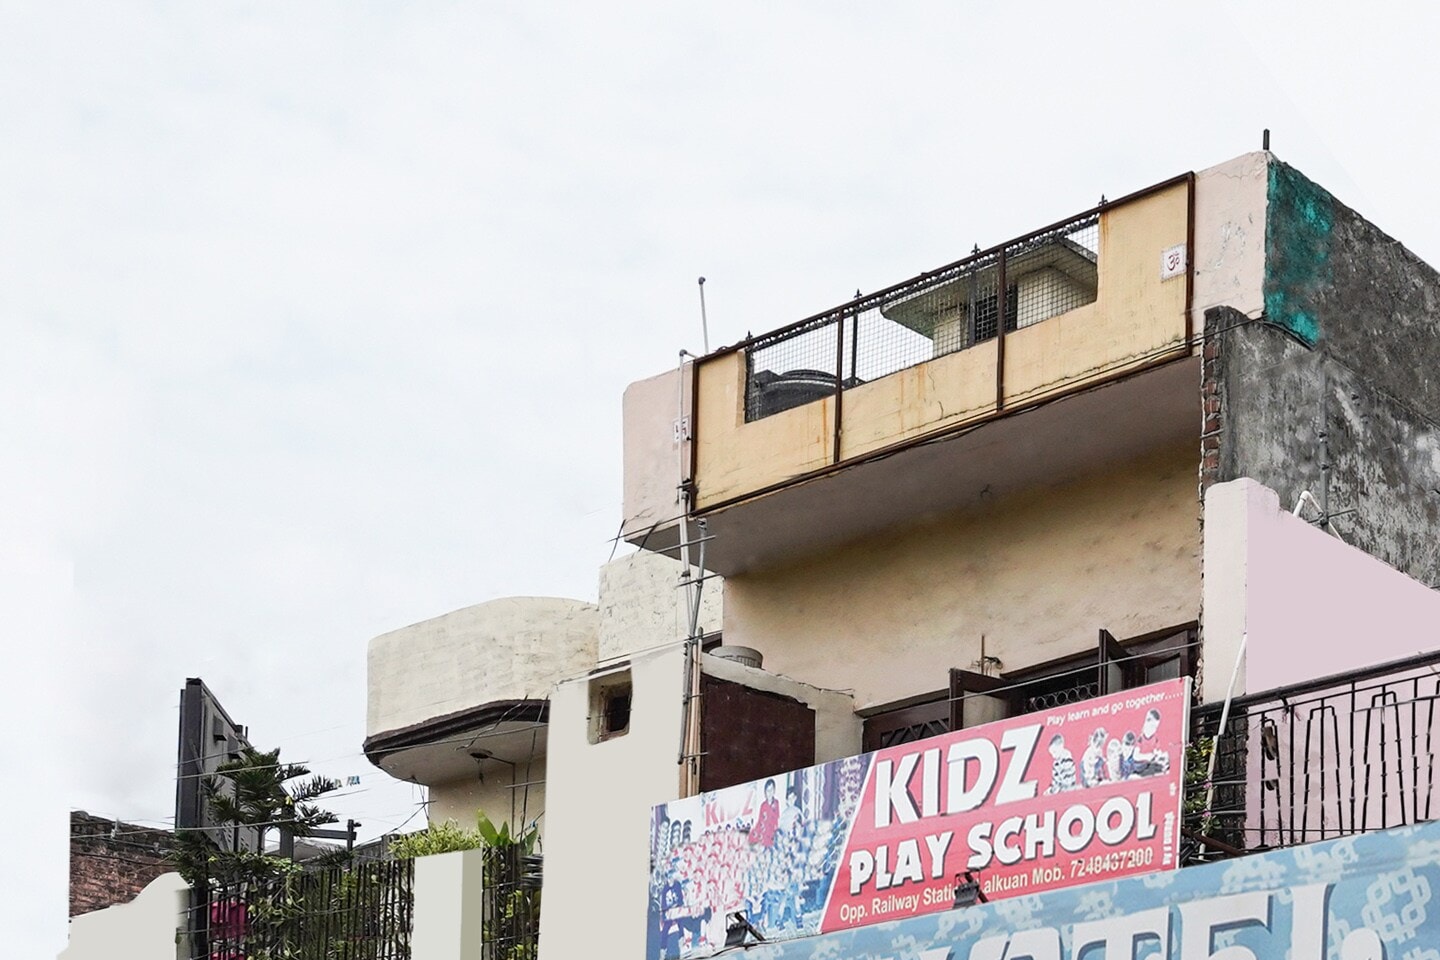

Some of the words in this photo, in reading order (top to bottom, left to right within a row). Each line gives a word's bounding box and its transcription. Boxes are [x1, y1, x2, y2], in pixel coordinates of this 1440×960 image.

[1046, 715, 1066, 726] Play
[1068, 711, 1090, 722] learn
[1092, 705, 1110, 716] and
[1111, 702, 1123, 714] go
[874, 723, 1044, 828] KIDZ
[850, 831, 953, 895] PLAY
[967, 791, 1158, 868] SCHOOL
[840, 903, 868, 923] Opp.
[872, 893, 920, 915] Railway
[981, 873, 1028, 894] alkuan
[1032, 866, 1065, 886] Mob.
